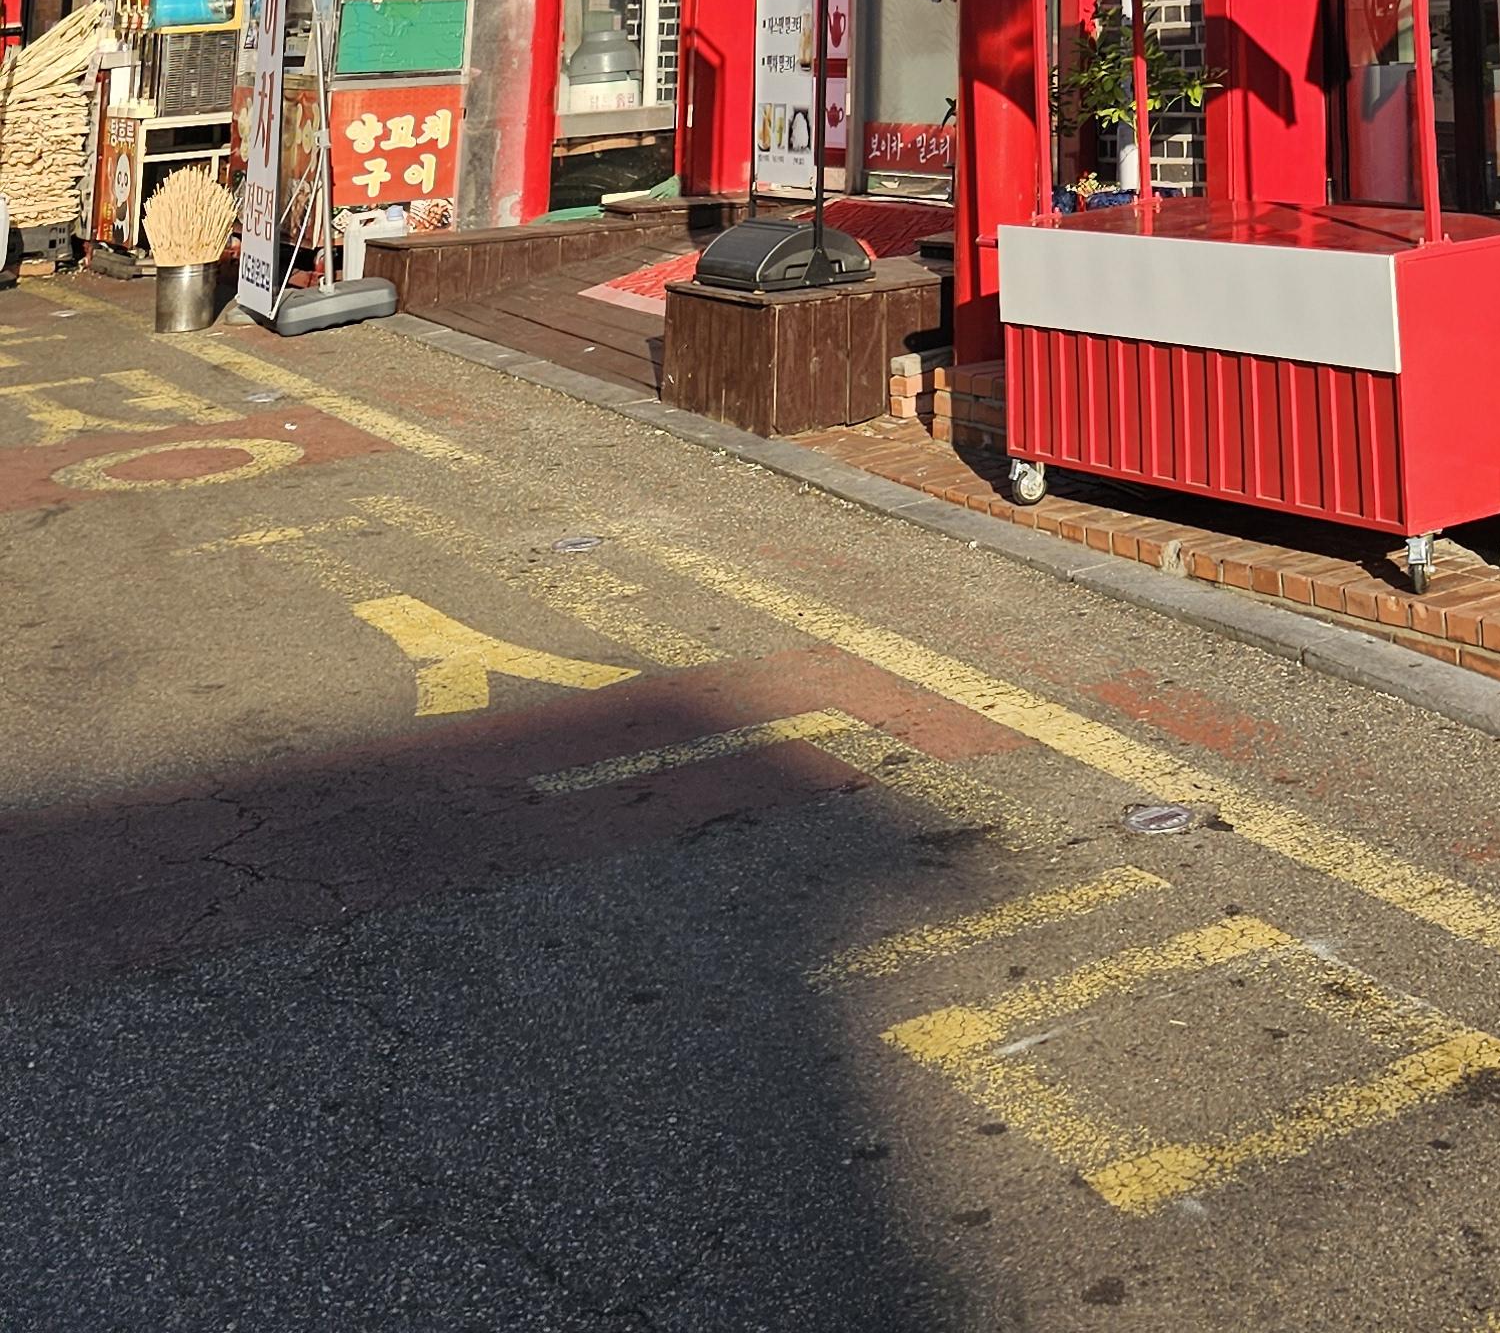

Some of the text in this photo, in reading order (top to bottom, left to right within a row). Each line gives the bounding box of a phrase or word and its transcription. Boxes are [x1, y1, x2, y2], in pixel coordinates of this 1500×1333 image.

[345, 108, 452, 154] 양꼬치
[867, 132, 951, 164] 보이차 밀크티
[351, 153, 437, 198] 구이
[245, 180, 275, 241] 전문점
